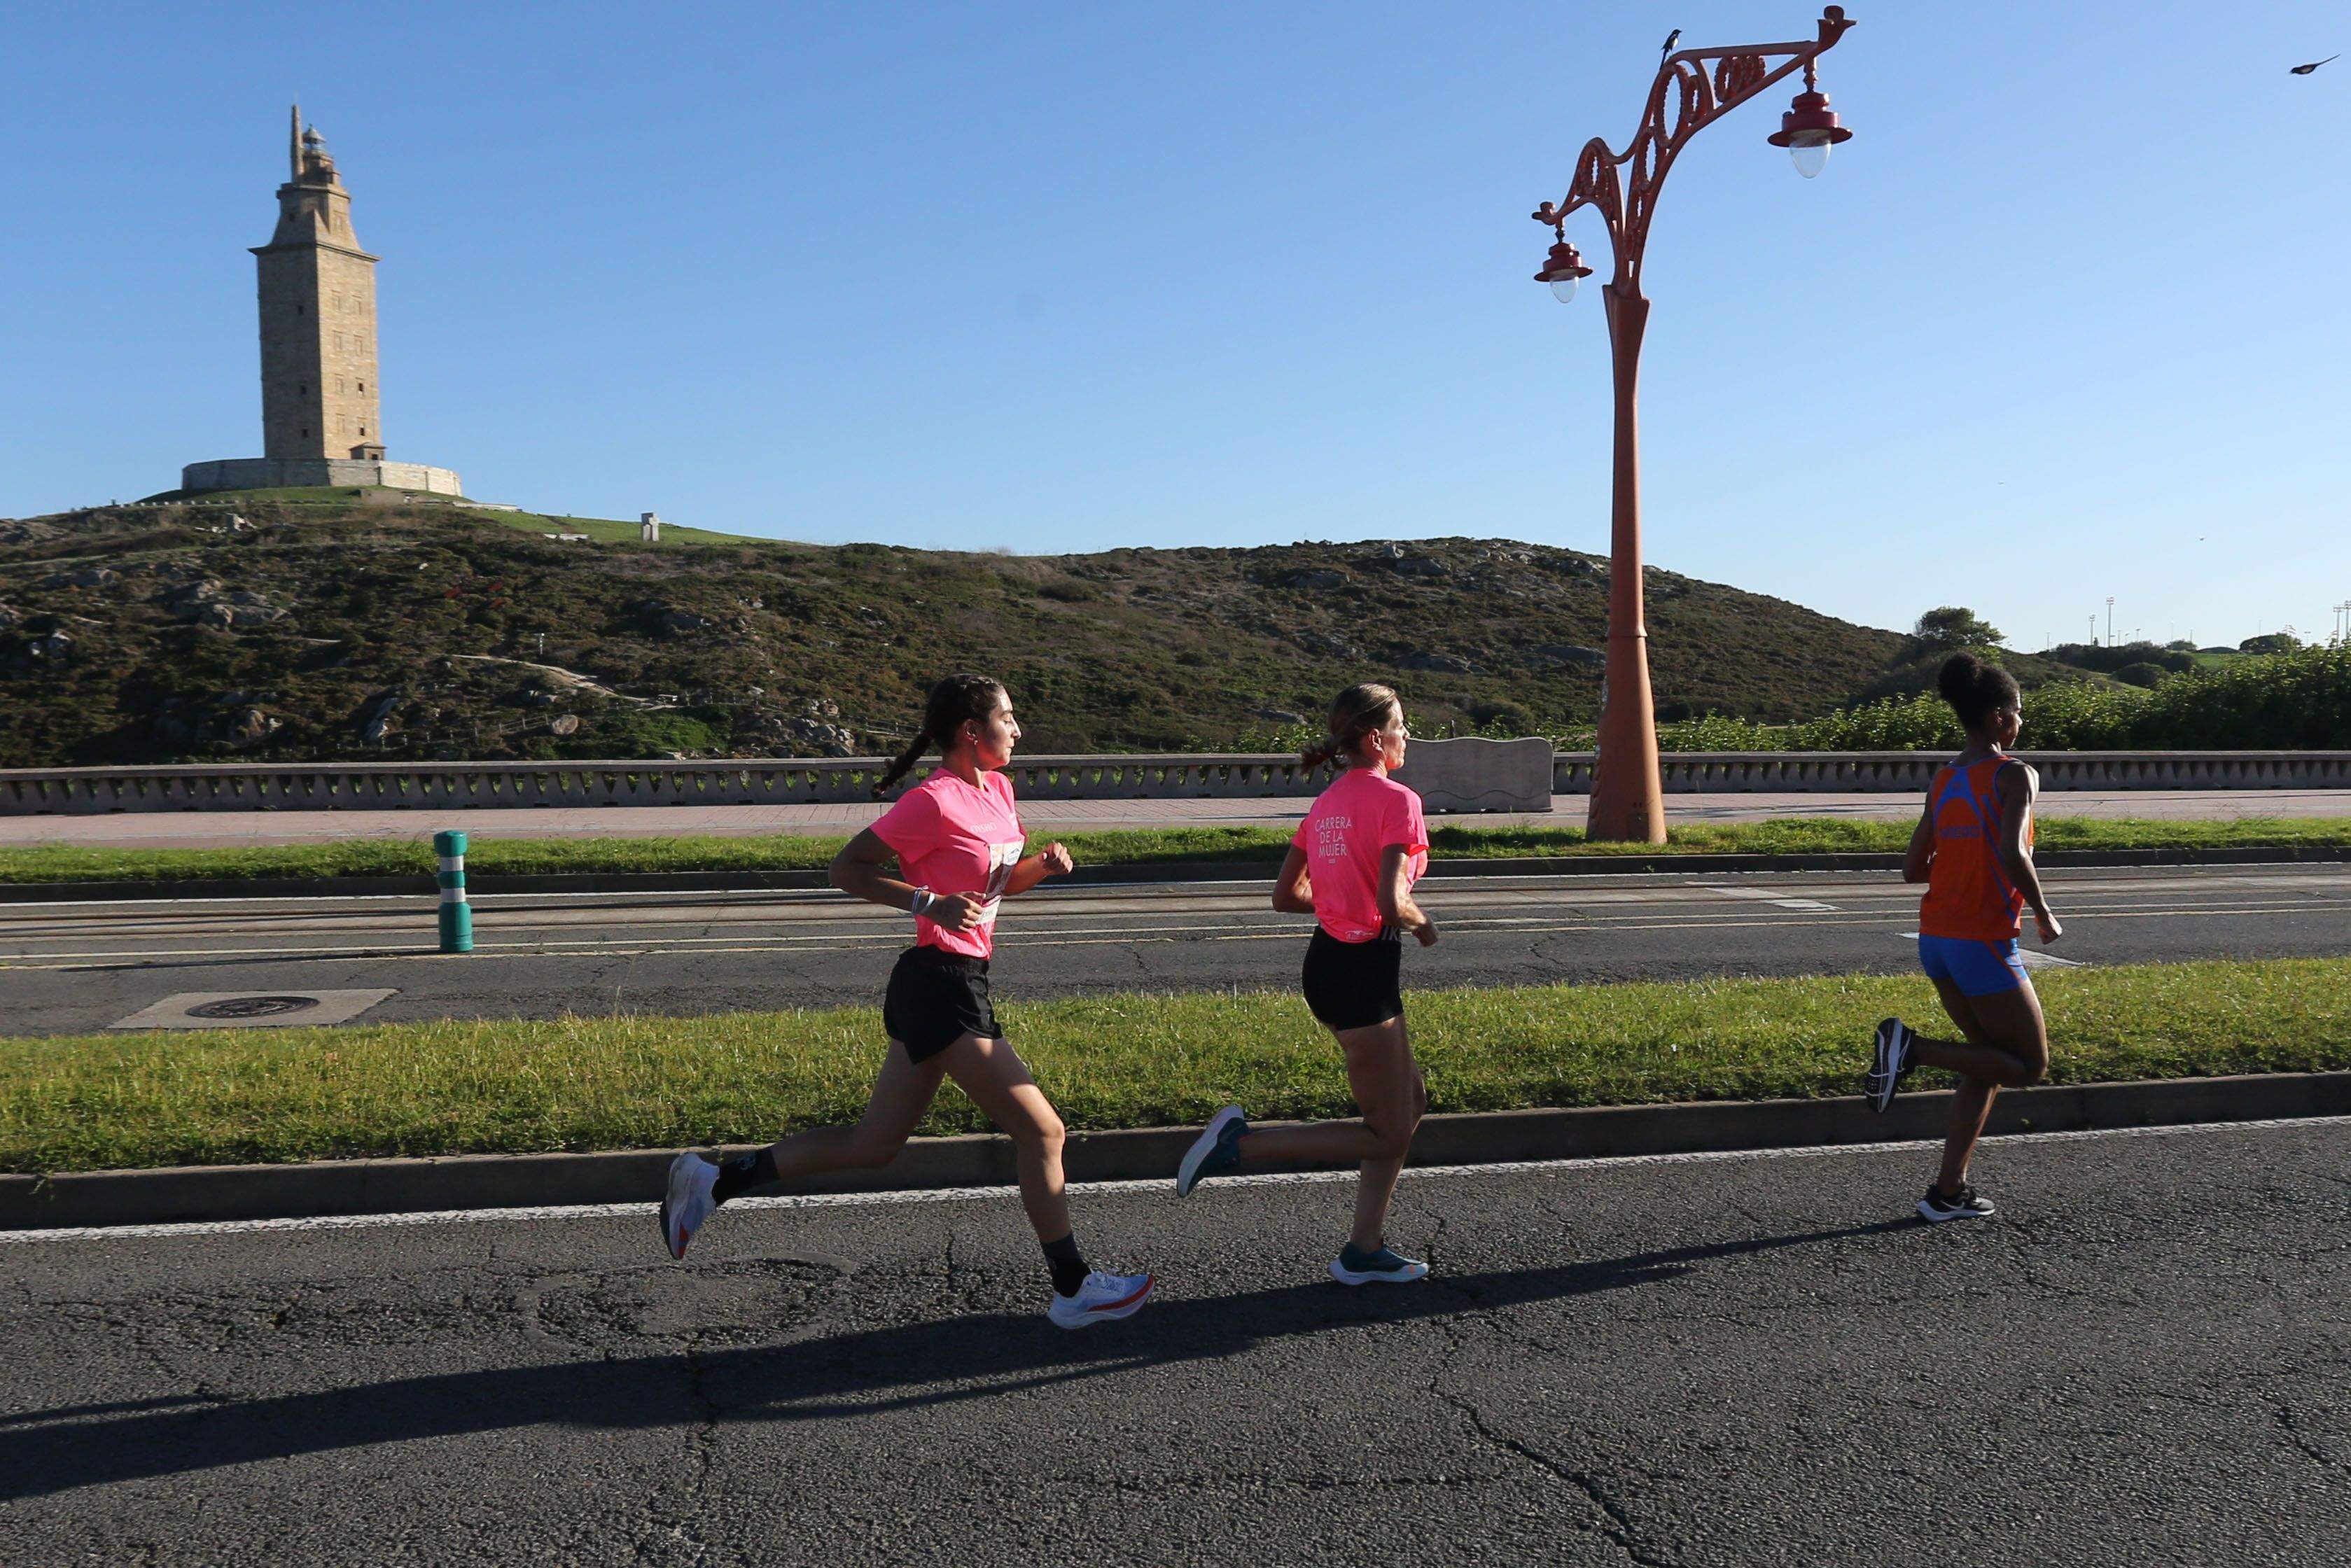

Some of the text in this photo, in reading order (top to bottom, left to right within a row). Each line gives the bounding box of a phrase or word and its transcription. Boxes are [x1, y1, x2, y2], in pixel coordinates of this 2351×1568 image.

[1315, 816, 1352, 832] CARRERA
[1320, 830, 1344, 844] DE LA
[1318, 844, 1348, 858] MUJER
